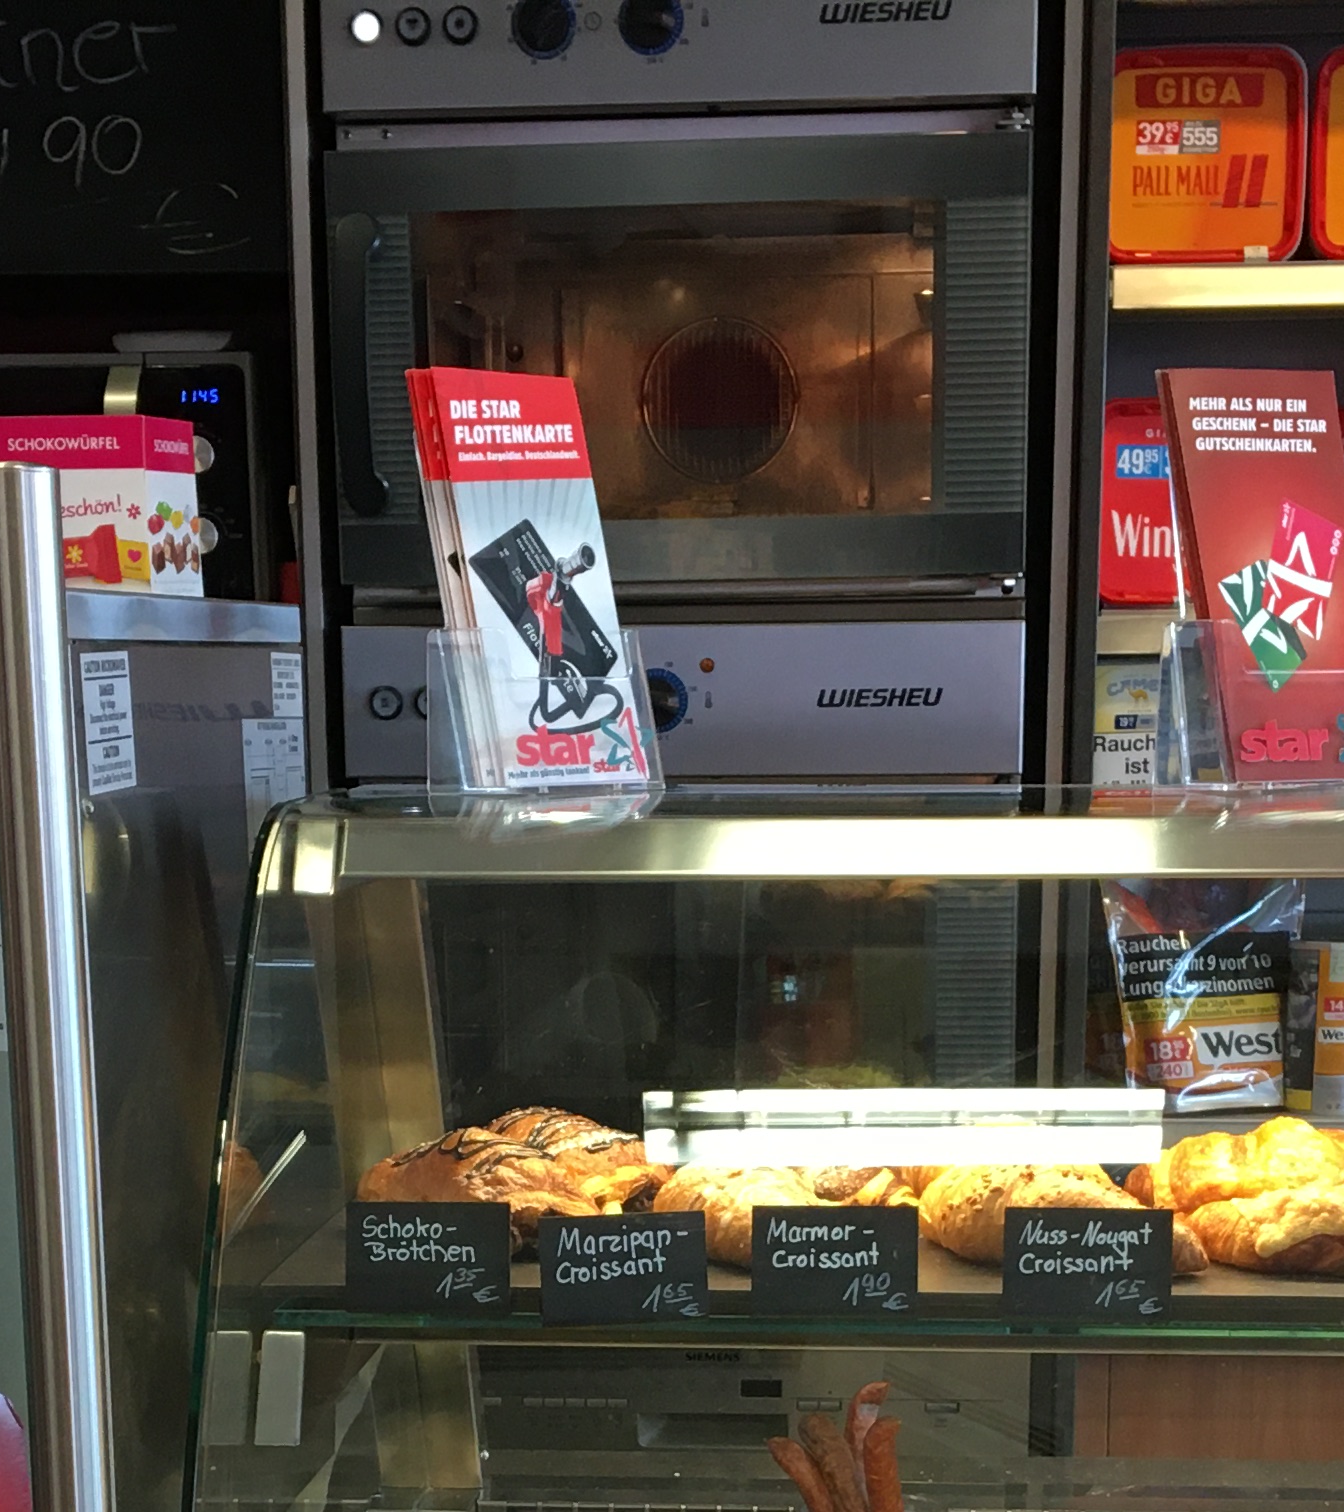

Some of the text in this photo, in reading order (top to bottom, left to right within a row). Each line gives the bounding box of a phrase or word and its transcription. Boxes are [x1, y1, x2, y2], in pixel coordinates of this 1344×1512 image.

[820, 0, 953, 25] WIESHEU
[1156, 76, 1242, 104] GIGA
[1132, 164, 1219, 197] PALL MALL
[450, 400, 521, 420] DIE STAR
[1189, 397, 1307, 412] MEHR ALS NUR EIN
[454, 424, 574, 445] FLOTTENKARTE
[1192, 417, 1326, 433] GESCHENK DIE STAR
[7, 434, 120, 452] SCHOKOWÜRFEL
[1196, 438, 1316, 453] GUTSCHEINKARTEN.
[524, 450, 581, 462] Deutschlandweit.
[816, 687, 944, 708] WIESHEU
[515, 723, 596, 767] star
[1241, 718, 1330, 762] star
[1207, 956, 1217, 971] 9
[1201, 1029, 1283, 1058] West
[363, 1215, 457, 1241] Schoko-
[371, 1241, 476, 1265] Brötchen
[557, 1226, 688, 1258] Marzipan-
[556, 1256, 667, 1284] Croissant
[772, 1248, 880, 1270] Croissant
[1019, 1252, 1133, 1275] Croissant
